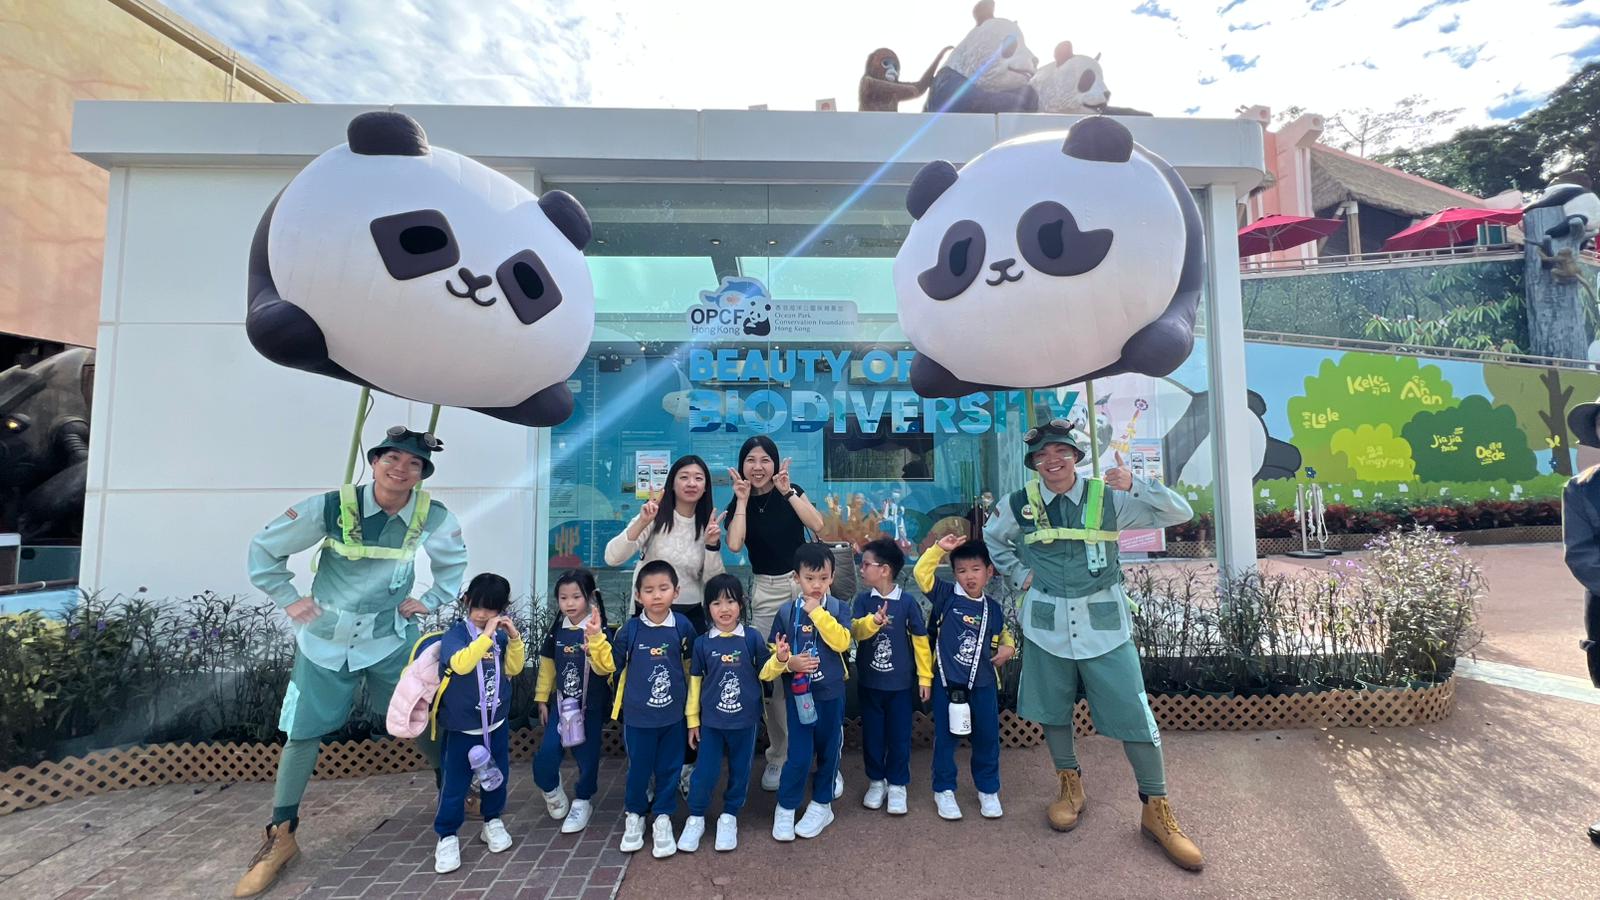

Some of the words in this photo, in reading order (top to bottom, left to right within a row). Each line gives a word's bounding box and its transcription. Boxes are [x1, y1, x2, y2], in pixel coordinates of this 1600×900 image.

[690, 308, 745, 325] OPCF
[691, 326, 716, 336] Hong
[717, 326, 740, 335] Kong
[690, 349, 852, 382] BEAUTY
[861, 350, 917, 383] OF
[689, 389, 1080, 434] BIODIVERSITY
[1311, 407, 1340, 429] Lele
[1475, 445, 1506, 461] Dede
